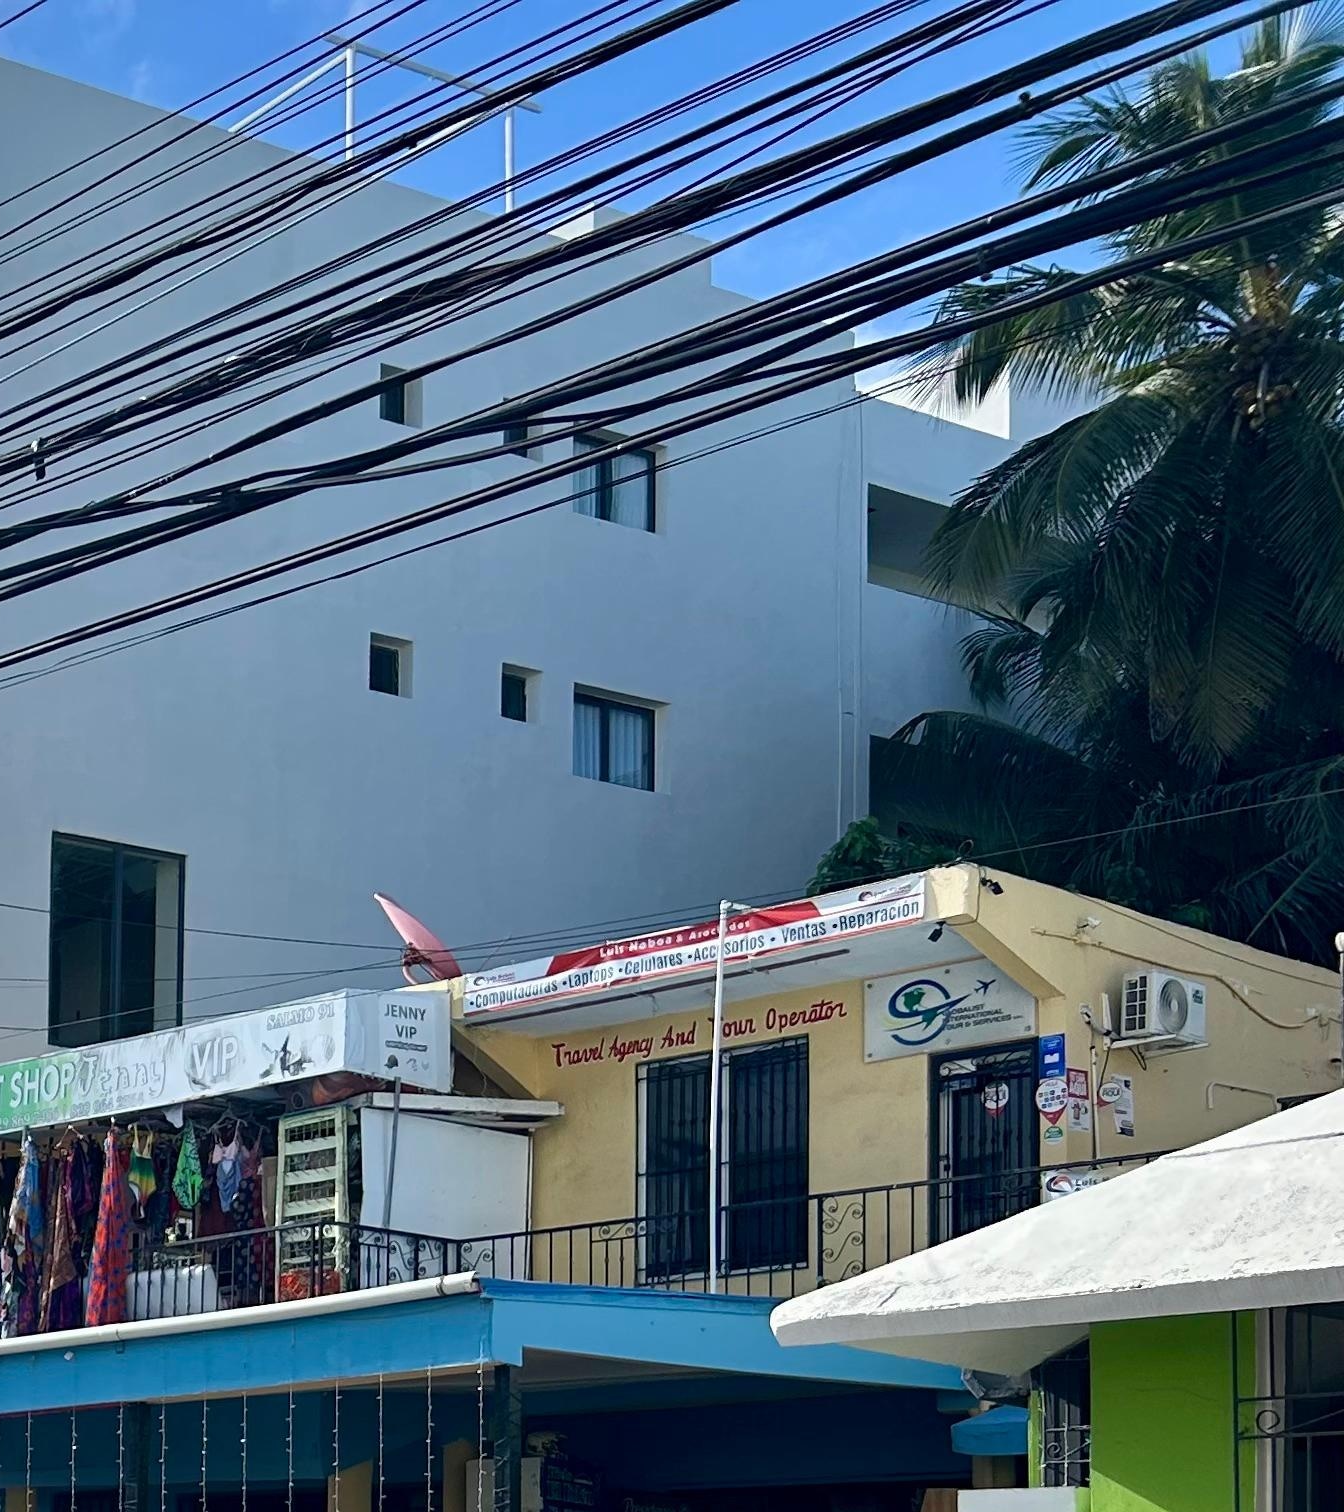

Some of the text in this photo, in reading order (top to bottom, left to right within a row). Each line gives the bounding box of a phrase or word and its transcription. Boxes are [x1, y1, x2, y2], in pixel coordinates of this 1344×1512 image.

[474, 900, 920, 1009] Computadoras Laptops Celulares Accsorios Ventas Reparación
[599, 945, 624, 959] Luis
[628, 935, 673, 953] Noboa
[266, 1001, 336, 1031] SALMO 91
[384, 1004, 426, 1021] JENNY
[395, 1024, 418, 1039] VIP
[552, 1037, 605, 1067] Travel
[608, 1035, 655, 1062] Agency
[660, 1020, 697, 1050] And
[765, 998, 848, 1033] Operator
[9, 1062, 76, 1109] SHOP
[75, 1054, 168, 1099] Jenny
[190, 1035, 242, 1081] VIP
